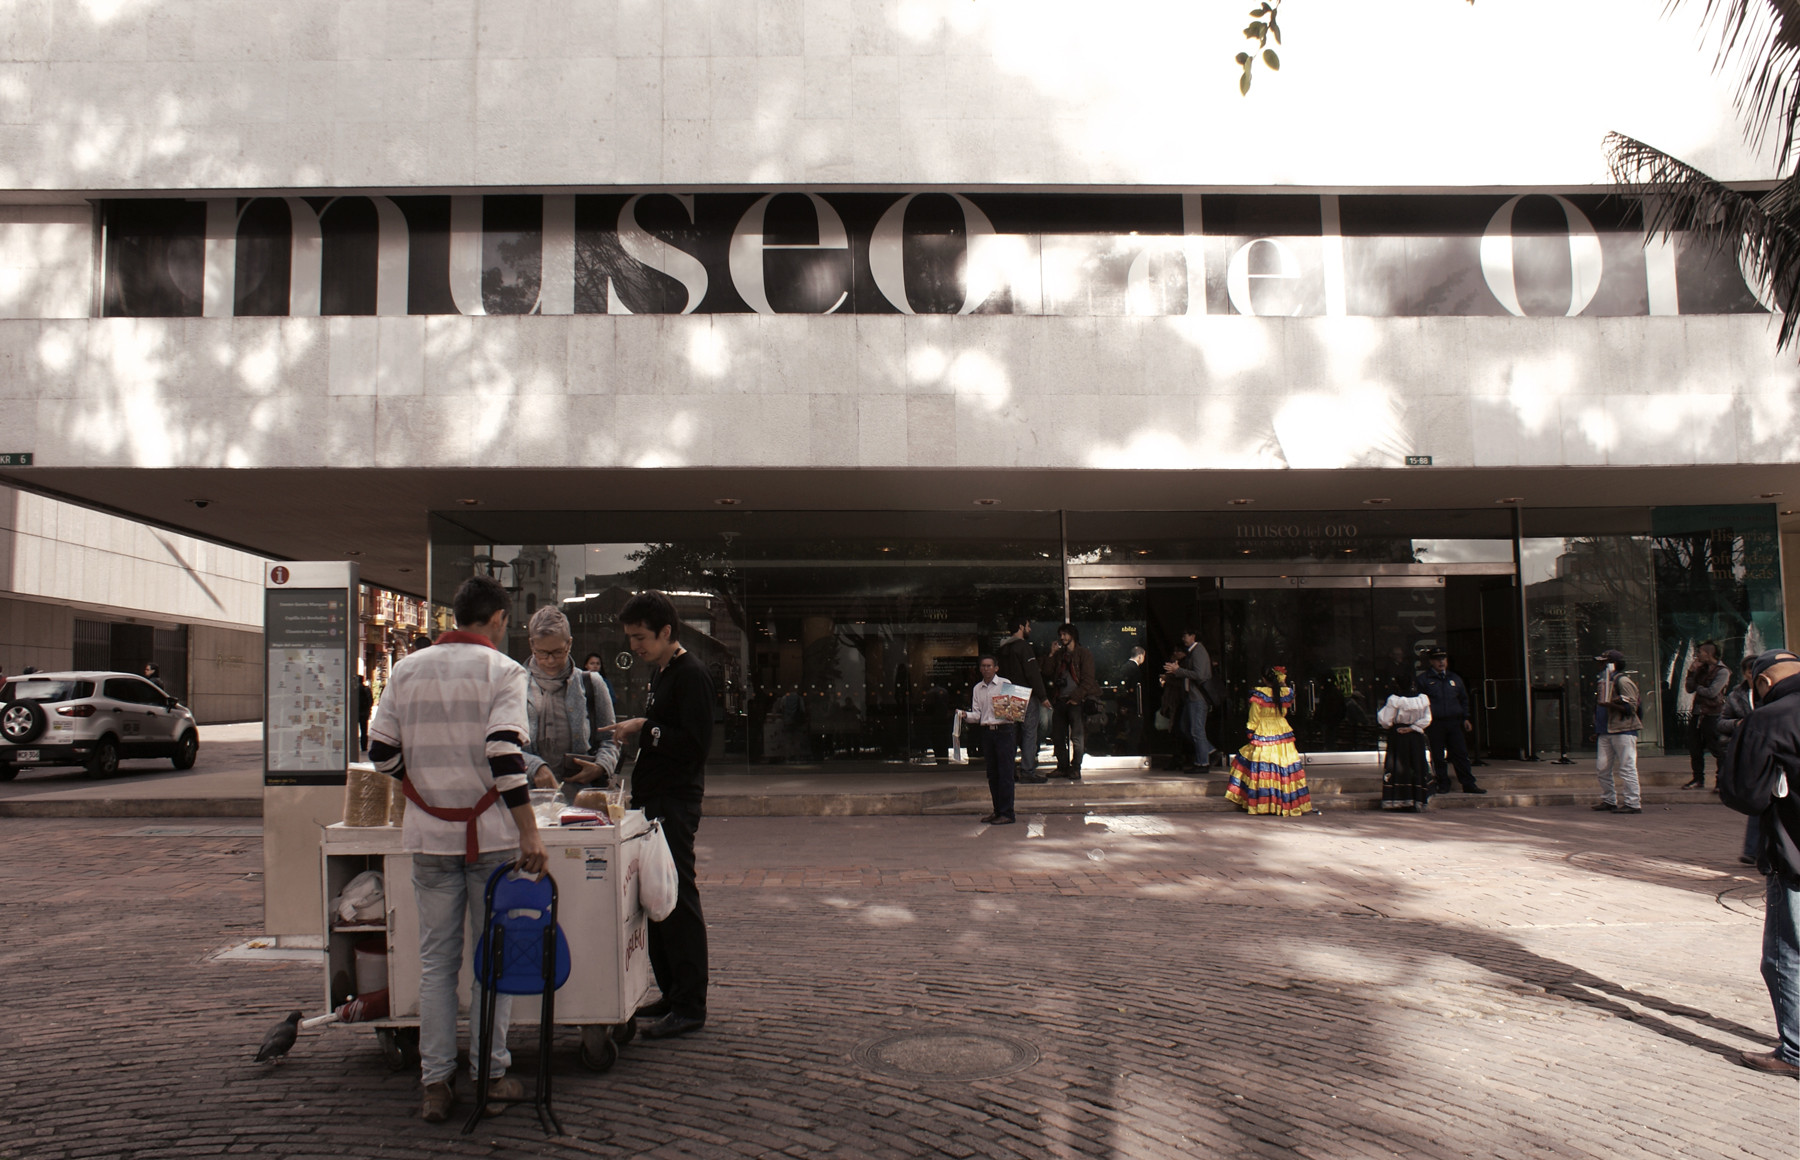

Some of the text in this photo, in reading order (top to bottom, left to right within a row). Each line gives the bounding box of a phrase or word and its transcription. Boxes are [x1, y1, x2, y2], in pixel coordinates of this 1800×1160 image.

[187, 192, 996, 317] museo
[1126, 192, 1348, 317] del
[20, 454, 27, 464] 6
[1236, 523, 1357, 538] museo del oro
